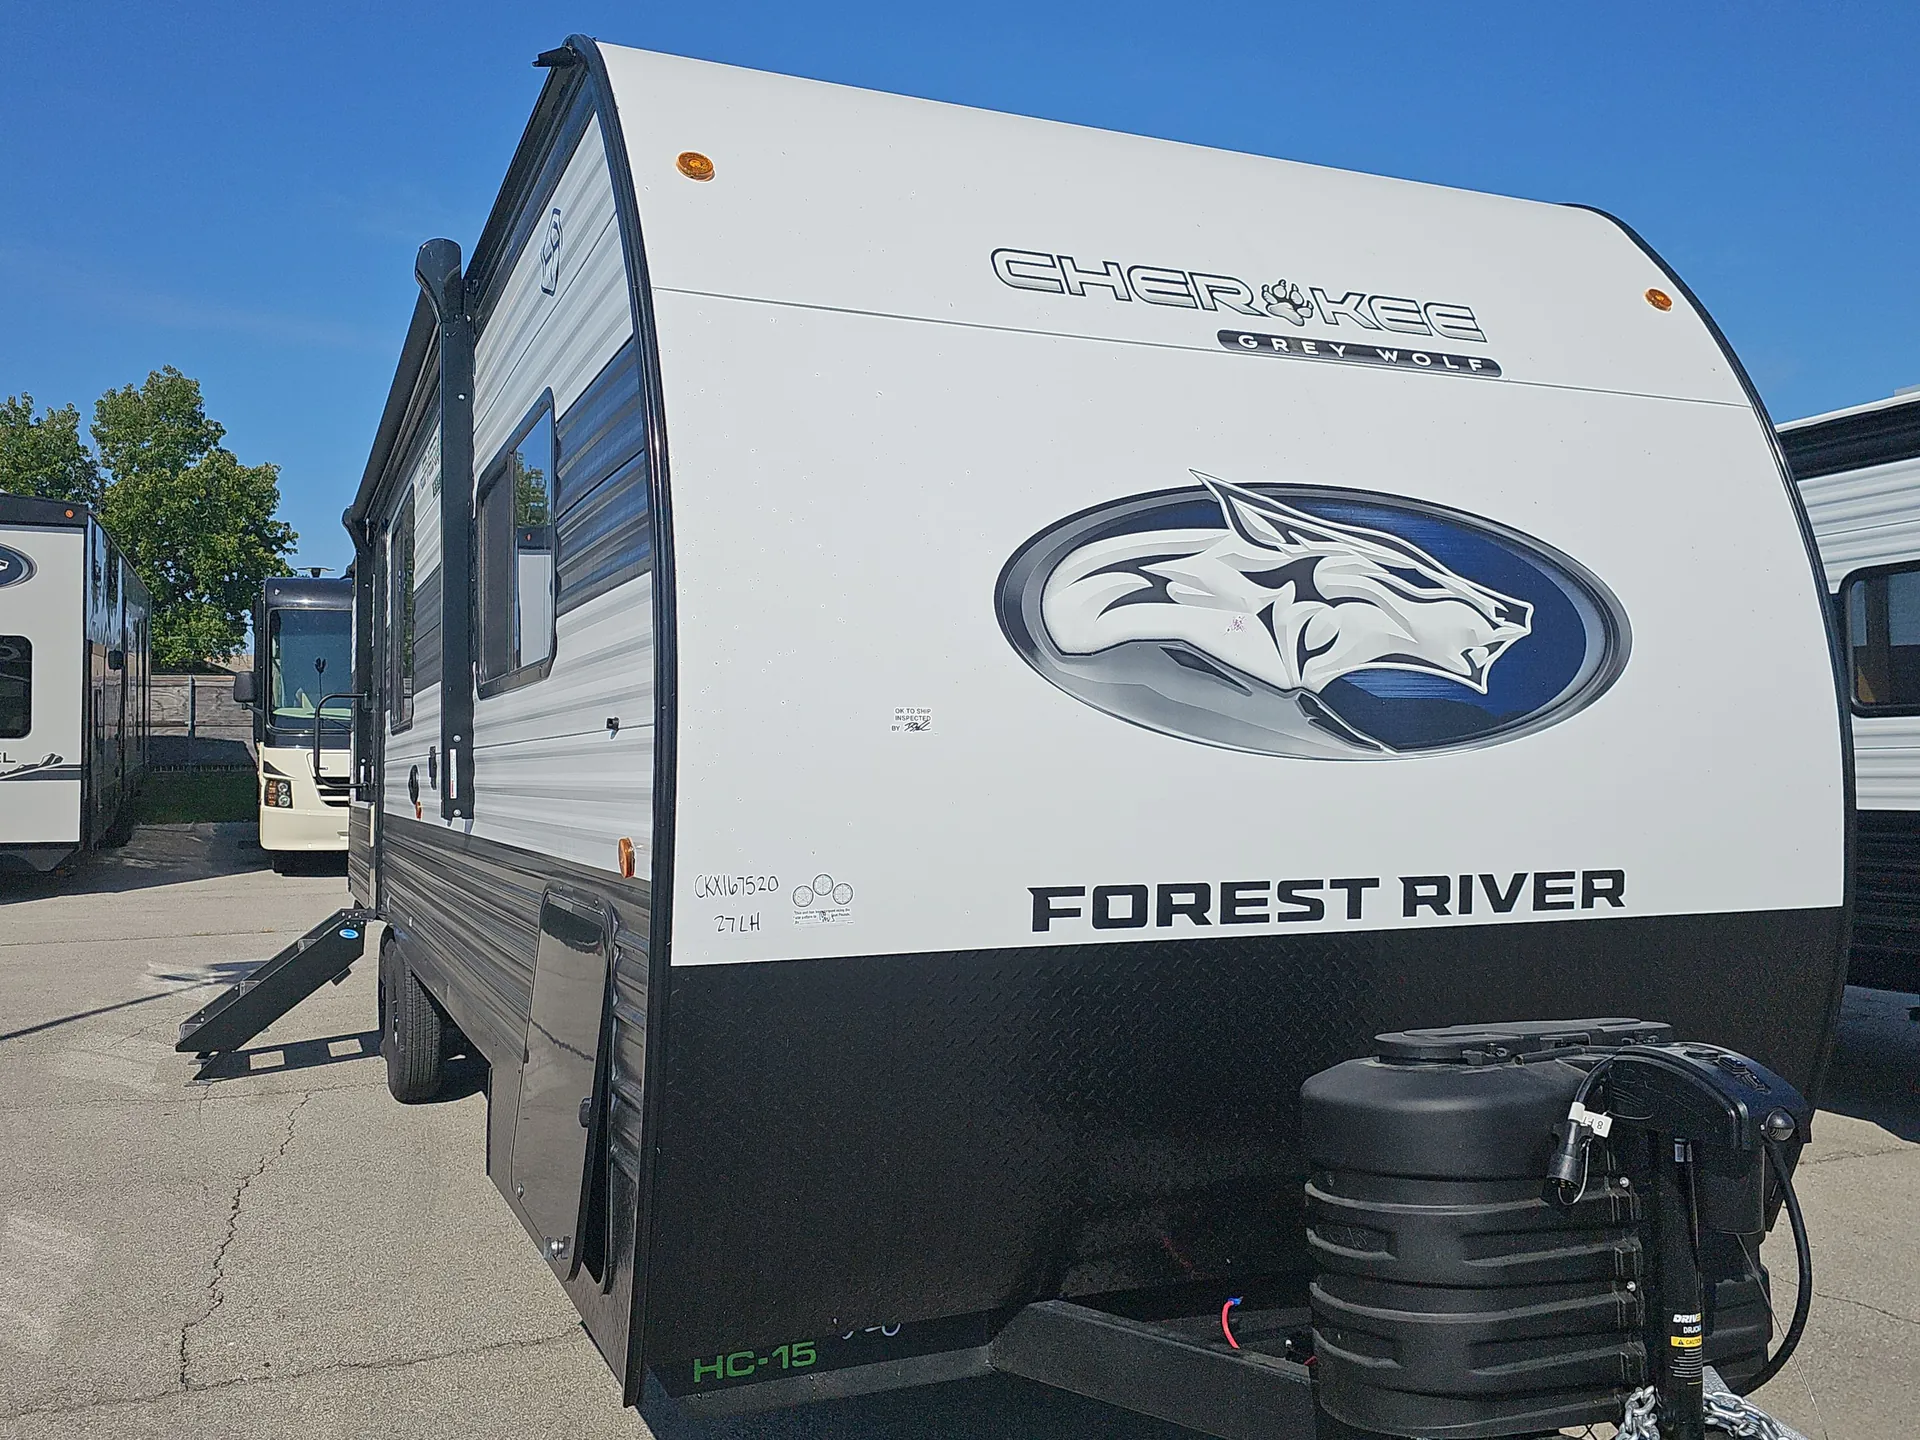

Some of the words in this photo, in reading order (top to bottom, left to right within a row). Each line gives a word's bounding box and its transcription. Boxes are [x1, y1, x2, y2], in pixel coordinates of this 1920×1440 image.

[1237, 334, 1346, 358] GREY
[1375, 348, 1485, 372] WOLF
[916, 707, 931, 715] SHIP
[1027, 877, 1380, 932] FOREST
[1397, 869, 1626, 918] RIVER
[1597, 1120, 1604, 1130] 8
[694, 1341, 817, 1383] HC-15
